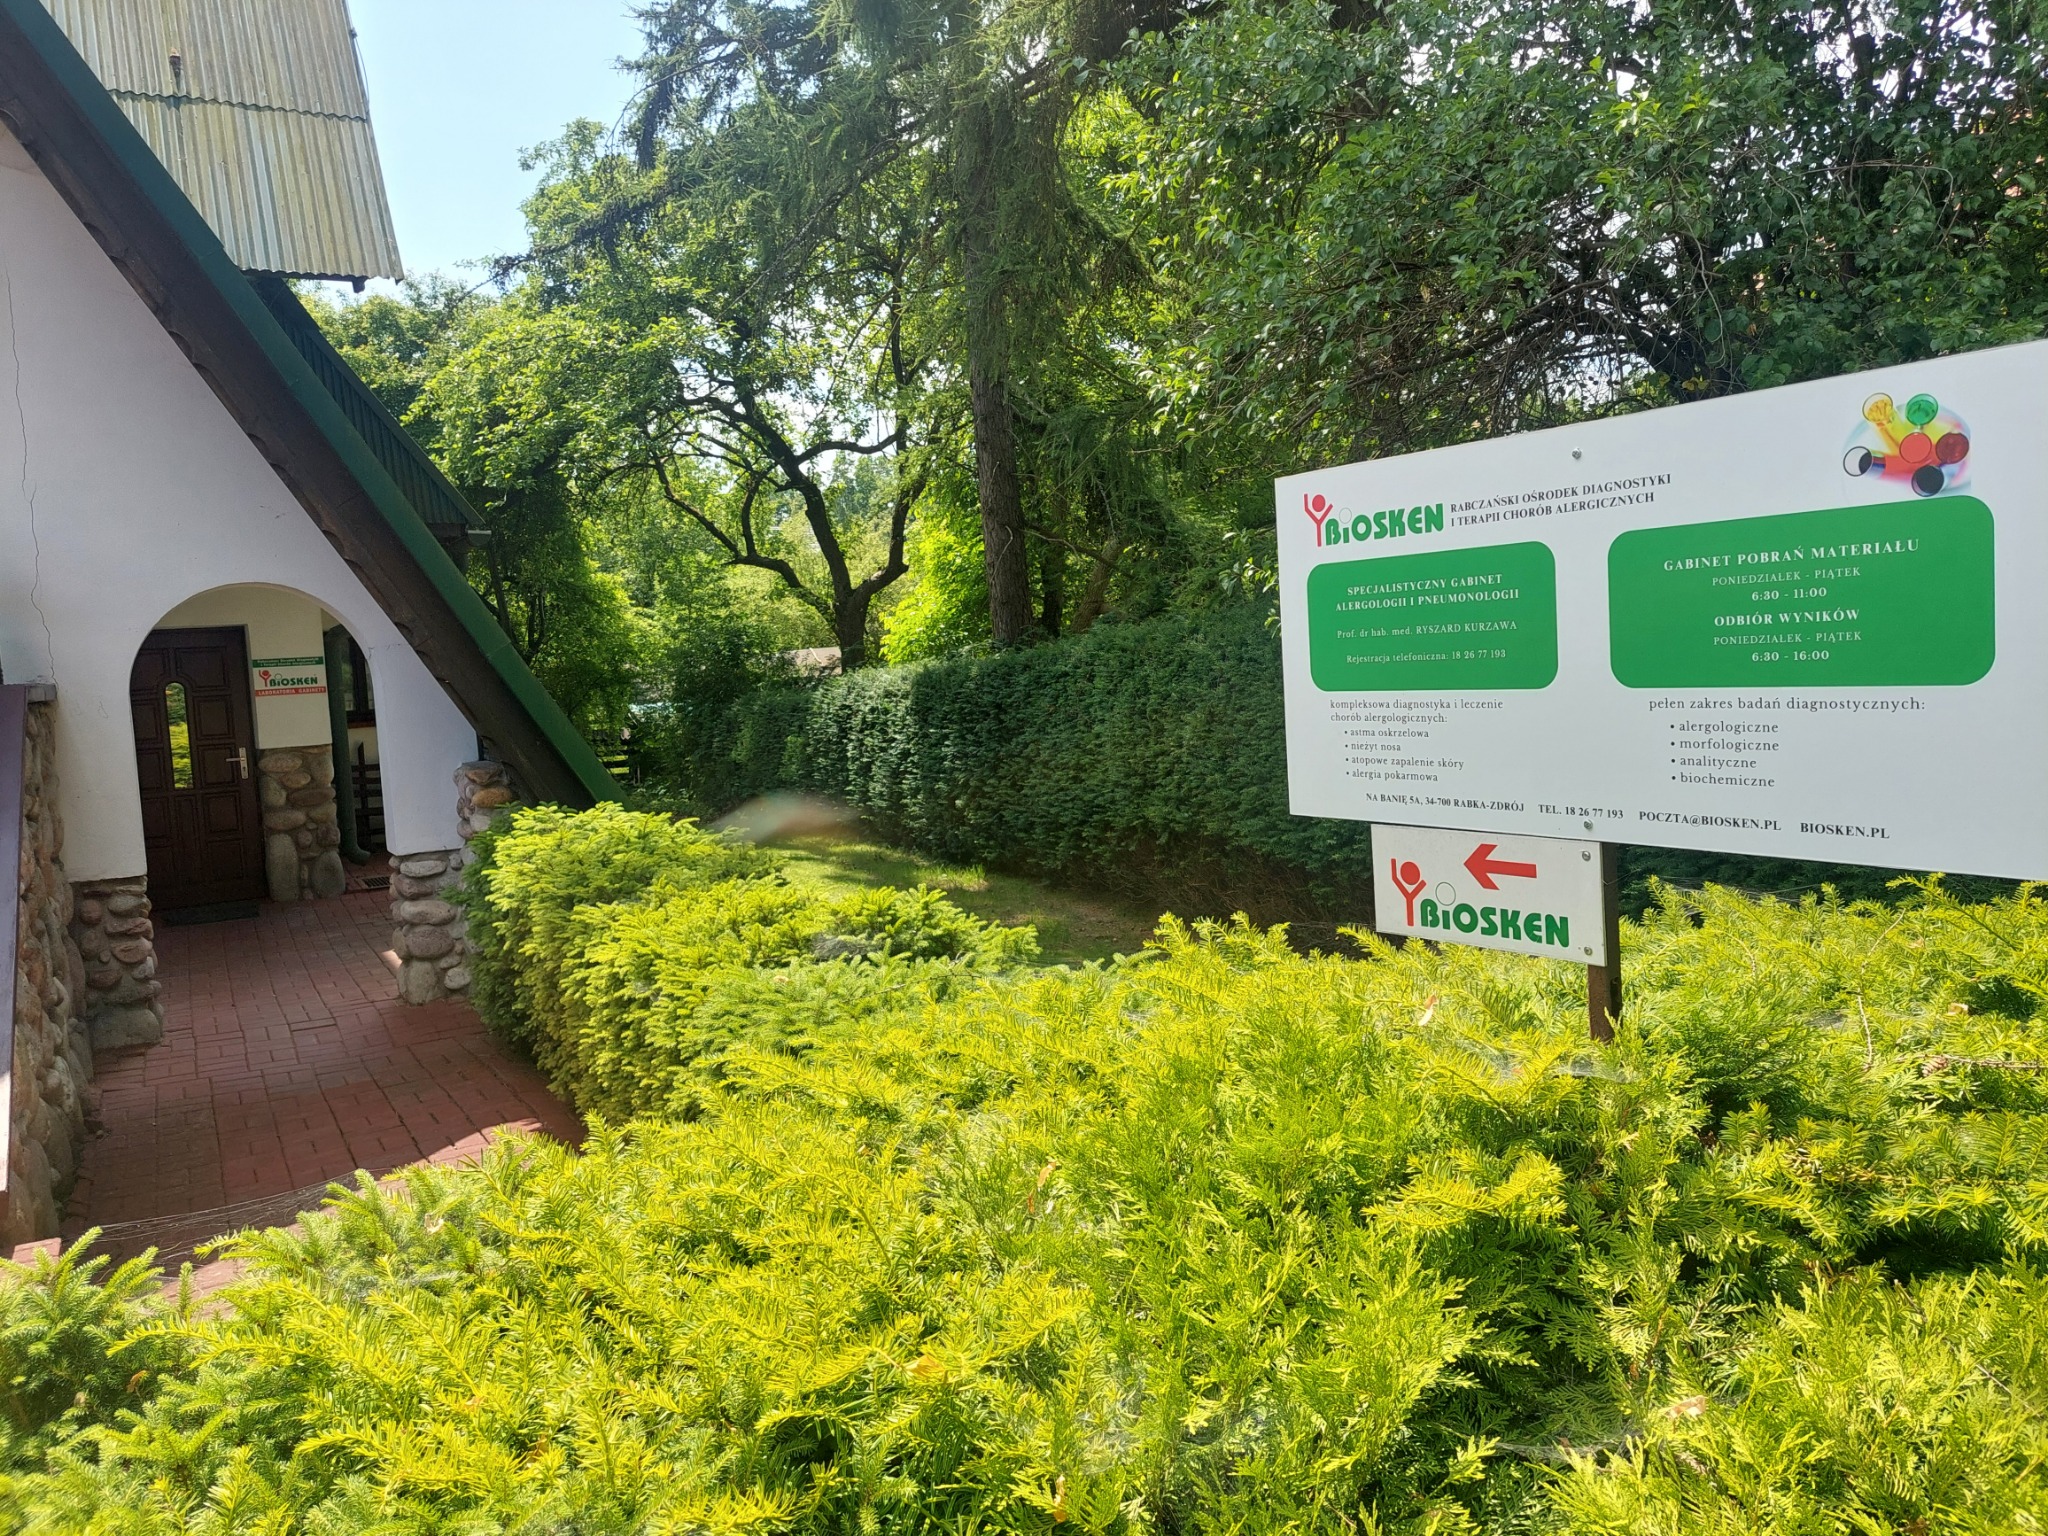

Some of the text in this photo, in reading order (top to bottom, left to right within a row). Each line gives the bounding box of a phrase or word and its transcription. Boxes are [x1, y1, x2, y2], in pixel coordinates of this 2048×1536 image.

[1450, 473, 1671, 513] RABCZAŃSKI OŚRODEK DIAGNOSTYKI
[1451, 492, 1654, 527] I TERAPII CHORÓB ALERGICZNYCH
[1664, 539, 1919, 571] GABINET POBRAŃ MATERIAŁU
[1712, 571, 1801, 586] PONIEDZIAŁEK
[1814, 567, 1860, 580] PIĄTEK
[1347, 574, 1503, 596] SPECJALISTYCZNY GABINET
[1335, 588, 1520, 611] ALERGOLOGII I PNEUMONOLOGII
[1752, 590, 1779, 601] 6:30
[1793, 587, 1827, 598] 11:00
[1714, 607, 1860, 626] ODBIÓR WYNIKÓW
[1337, 620, 1517, 639] Prof. dr hab. med. RYSZARD KURZAWA
[1713, 633, 1802, 645] PONIEDZIAŁEK
[1815, 631, 1862, 643] PIĄTEK
[1346, 649, 1506, 665] Rejestracja telefoniczna: 18 26 77 193
[1752, 651, 1779, 662] 6:30
[1794, 650, 1829, 661] 16:00
[1330, 699, 1503, 711] kompleksowa diagnostyka i leczenie
[1649, 697, 1926, 712] pełen zakres badań diagnostycznych:
[1330, 712, 1448, 725] chorób alergologicznych:
[1350, 727, 1429, 738] astma oskrzelowa
[1679, 721, 1779, 735] alergologiczne
[1351, 741, 1401, 752] nieżyt nosa
[1680, 738, 1779, 753] morfologiczne
[1351, 756, 1465, 770] atopowe zapalenie skóry
[1680, 755, 1757, 770] analityczne
[1352, 769, 1438, 782] alergia pokarmowa
[1680, 772, 1775, 787] biochemiczne
[1366, 793, 1890, 839] NA BANIĘ 5A, 34-700 RABKA-ZDRÓJ TEL. 18 26 77 193 POCZTA@BIOSKEN.PL BIOSKEN.PL
